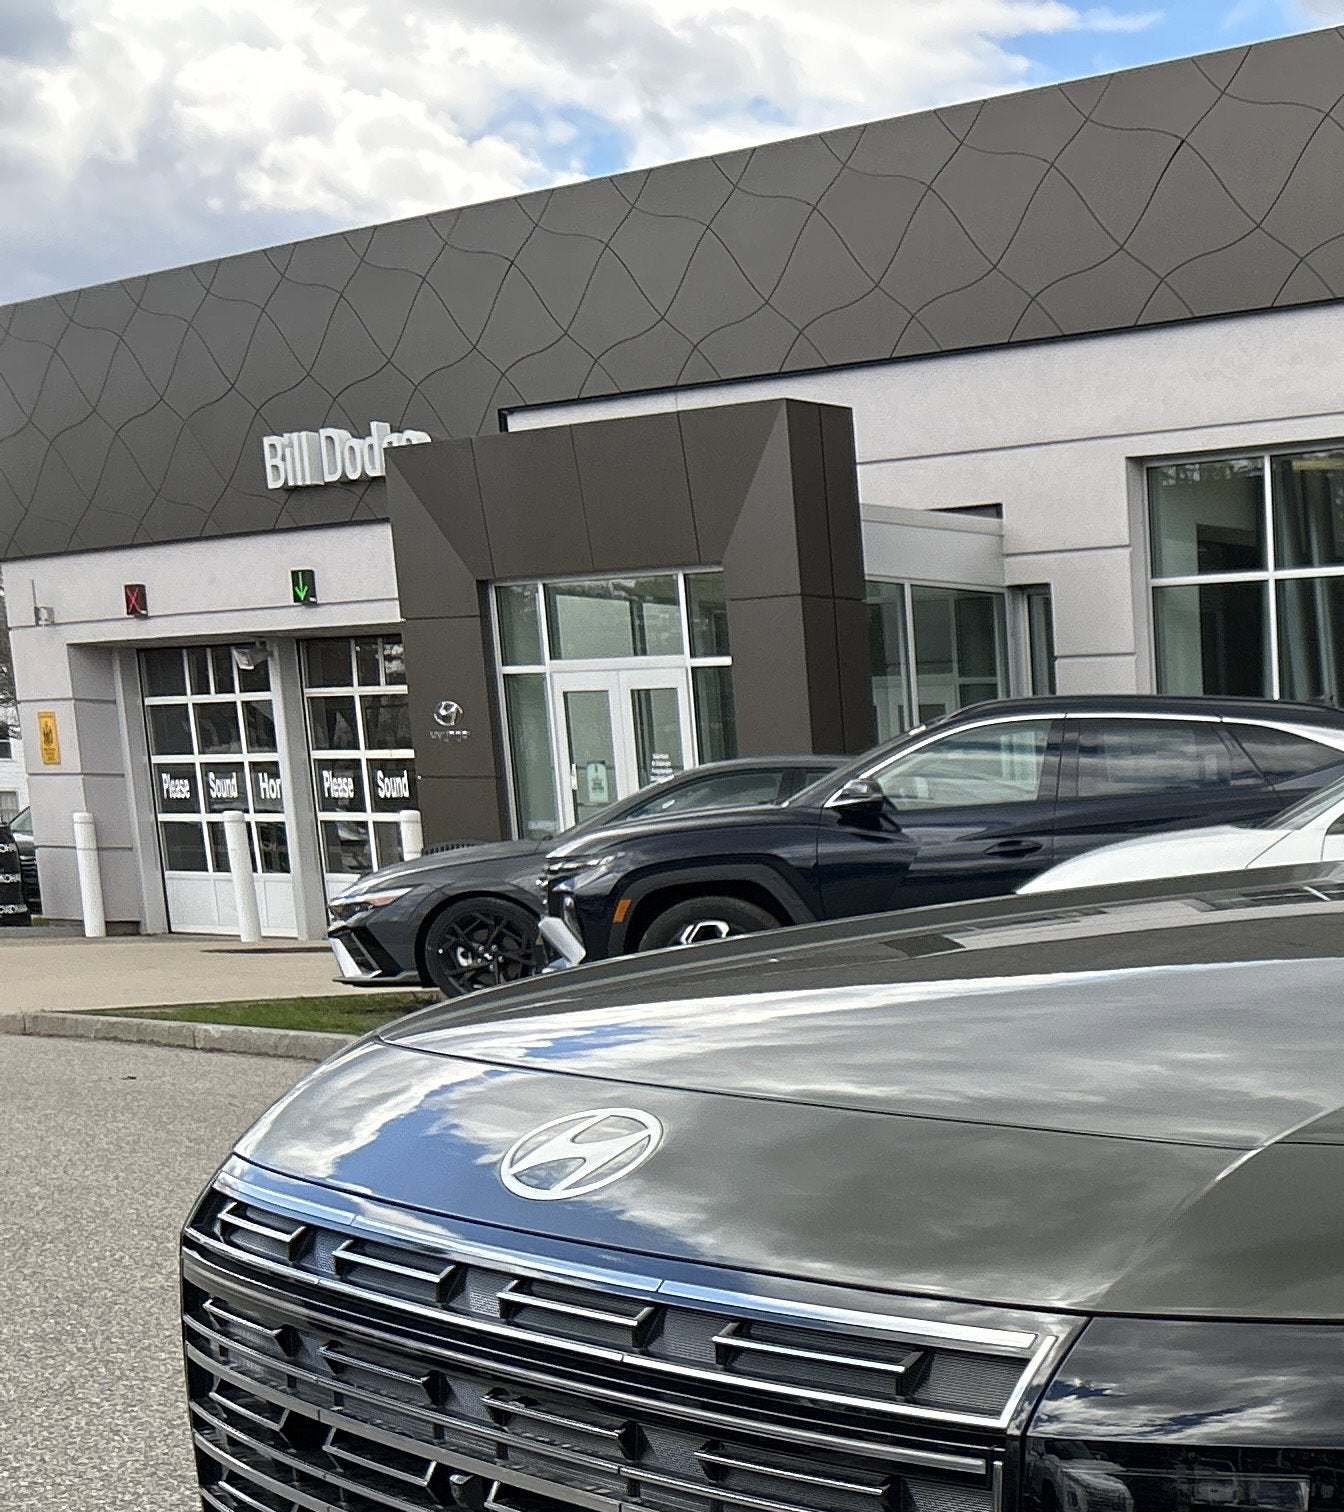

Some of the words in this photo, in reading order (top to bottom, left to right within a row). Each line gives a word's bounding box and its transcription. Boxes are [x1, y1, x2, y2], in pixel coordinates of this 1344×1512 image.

[263, 431, 324, 489] Bill
[162, 773, 190, 799] Please
[208, 772, 238, 798] Sound
[322, 771, 354, 798] Please
[377, 770, 410, 799] Sound
